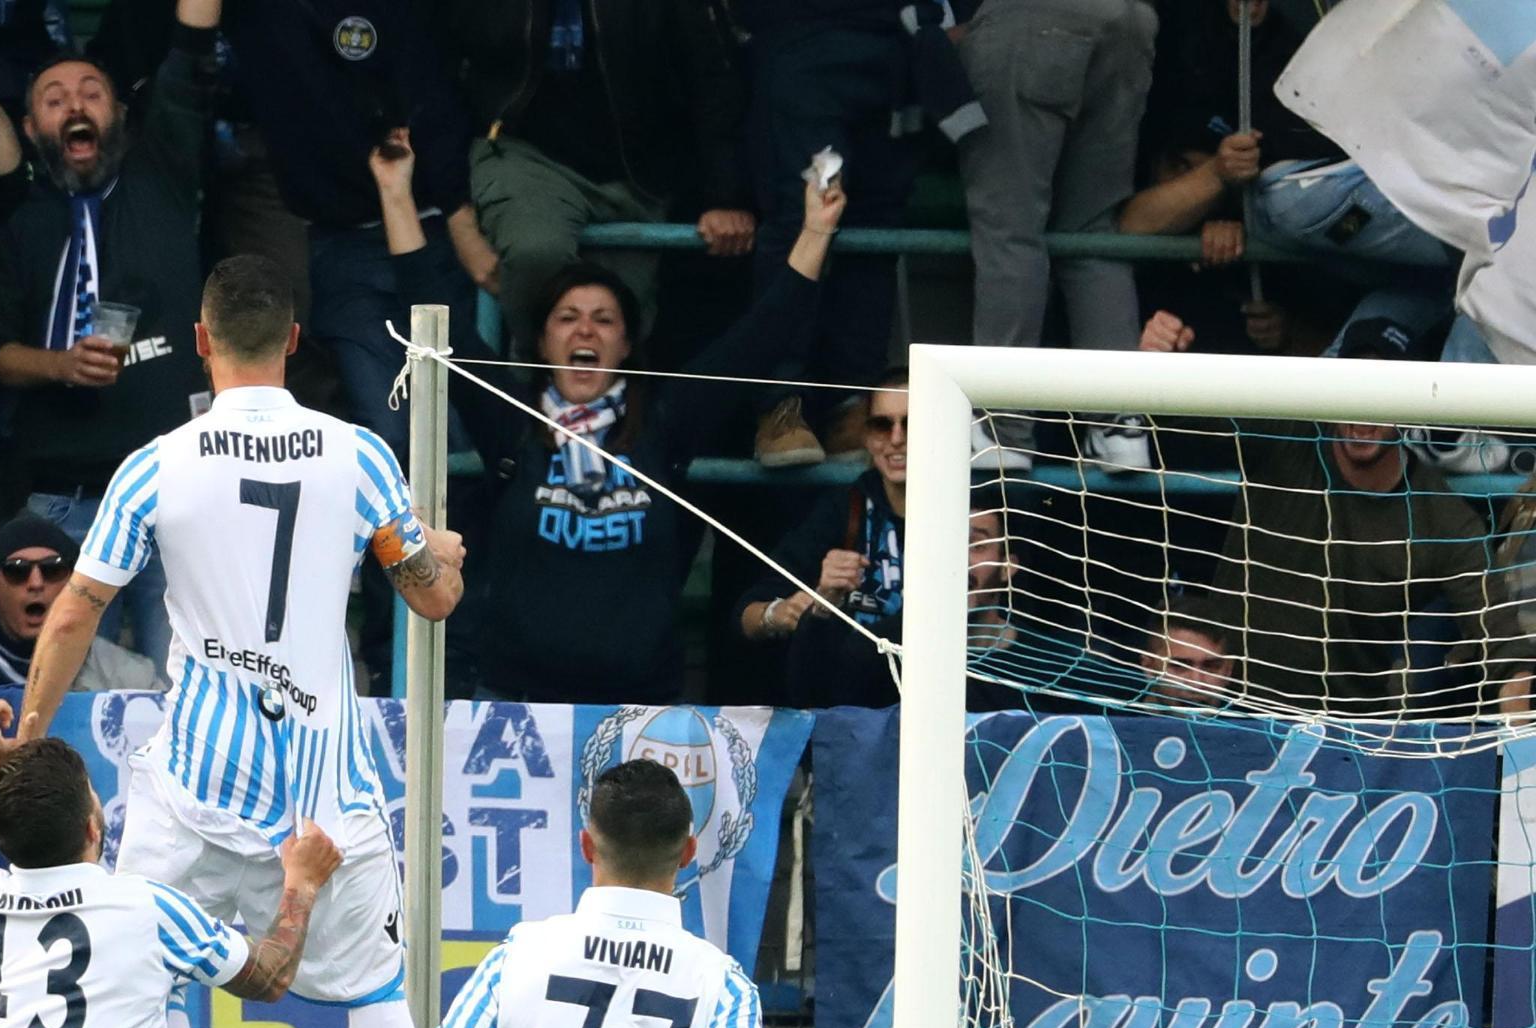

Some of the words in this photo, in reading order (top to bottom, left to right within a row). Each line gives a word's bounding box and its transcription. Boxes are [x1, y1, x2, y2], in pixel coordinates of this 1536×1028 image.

[199, 428, 324, 464] ANTENUCCI
[534, 485, 653, 515] FERARA
[537, 507, 647, 552] OVEST
[238, 477, 302, 644] 7
[583, 935, 674, 974] VIVIANI
